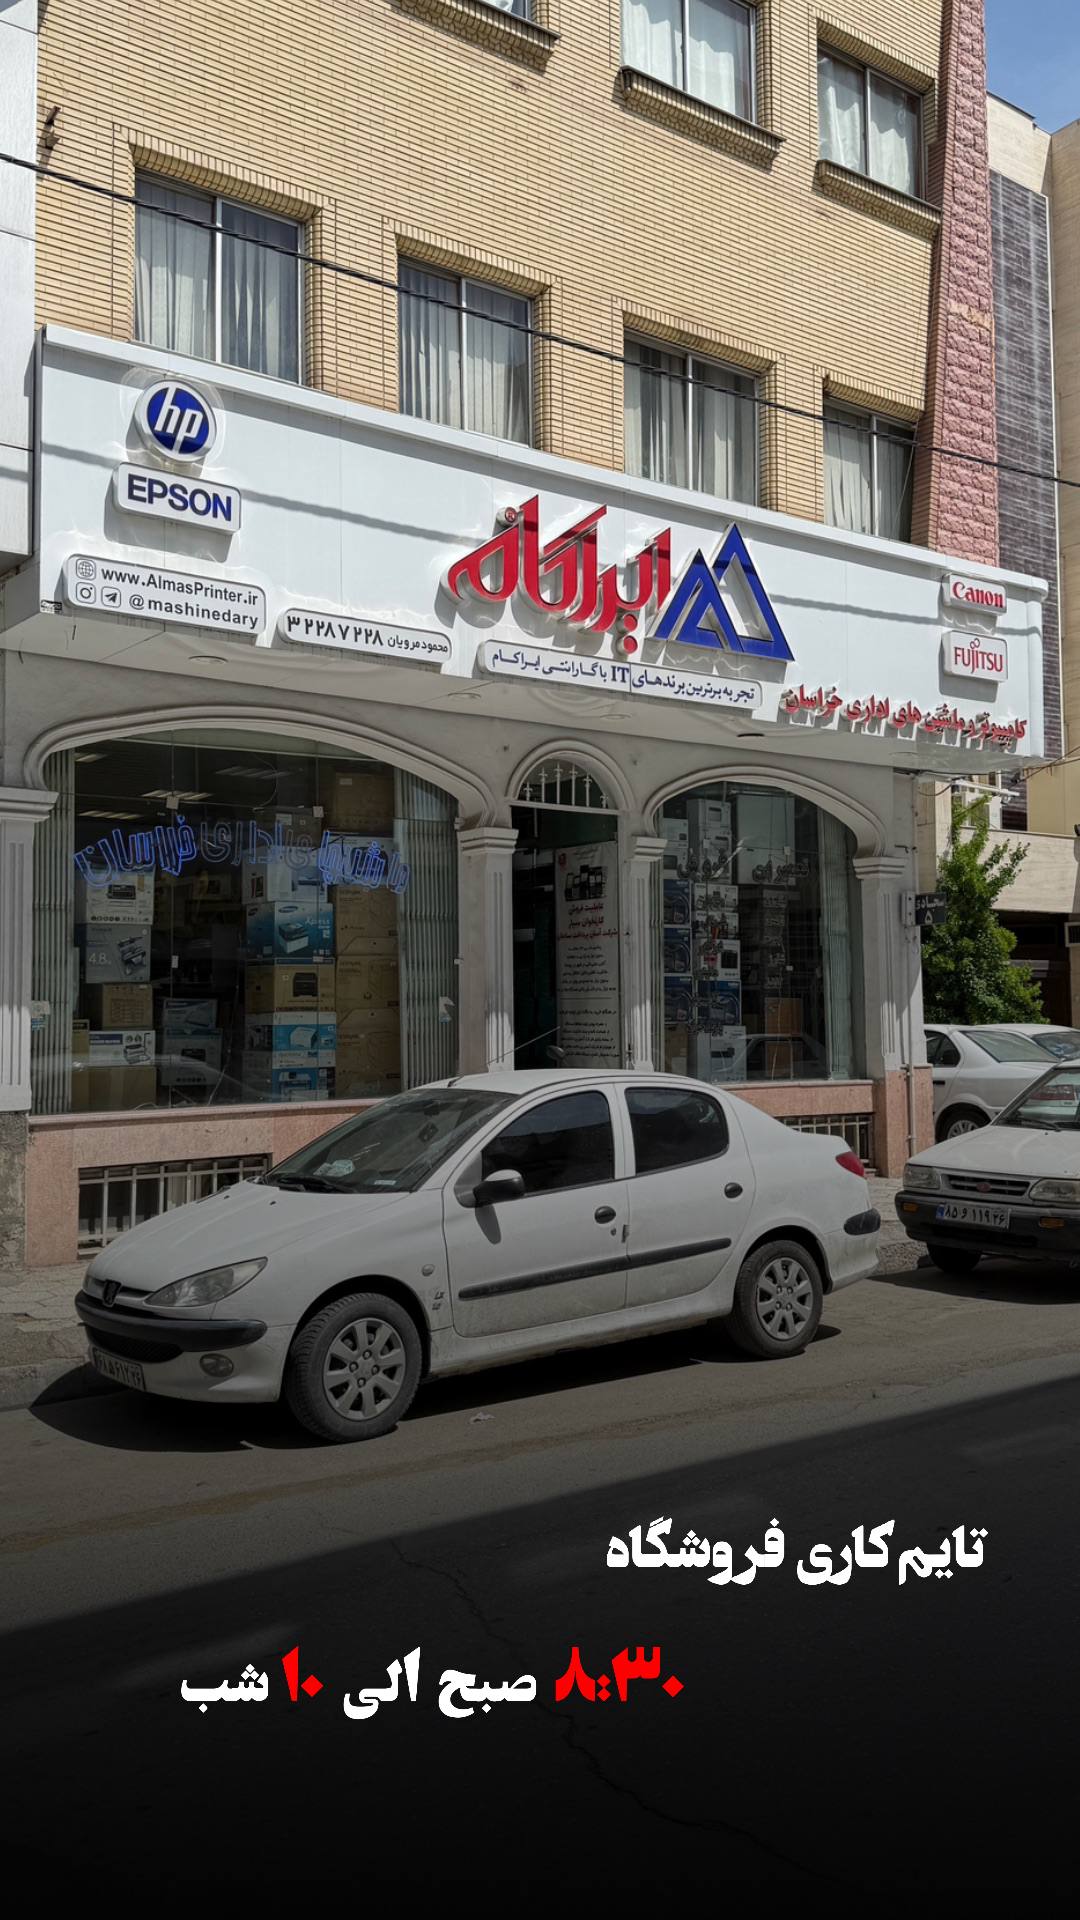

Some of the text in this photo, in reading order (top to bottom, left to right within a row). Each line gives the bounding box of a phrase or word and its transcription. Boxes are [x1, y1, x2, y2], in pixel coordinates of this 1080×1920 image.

[154, 386, 204, 455] hp
[127, 475, 232, 522] EPSON
[101, 568, 258, 606] www.AlmasPrinter.ir
[952, 581, 1004, 609] Canon
[492, 649, 541, 671] ایراکام
[542, 659, 599, 677] گارانتی
[954, 638, 1004, 674] FUJITSU
[611, 665, 630, 683] IT
[632, 669, 685, 694] برندهای
[686, 680, 722, 699] برترین
[722, 687, 755, 703] تجربه
[784, 684, 842, 718] خراسان
[846, 694, 890, 721] اداری
